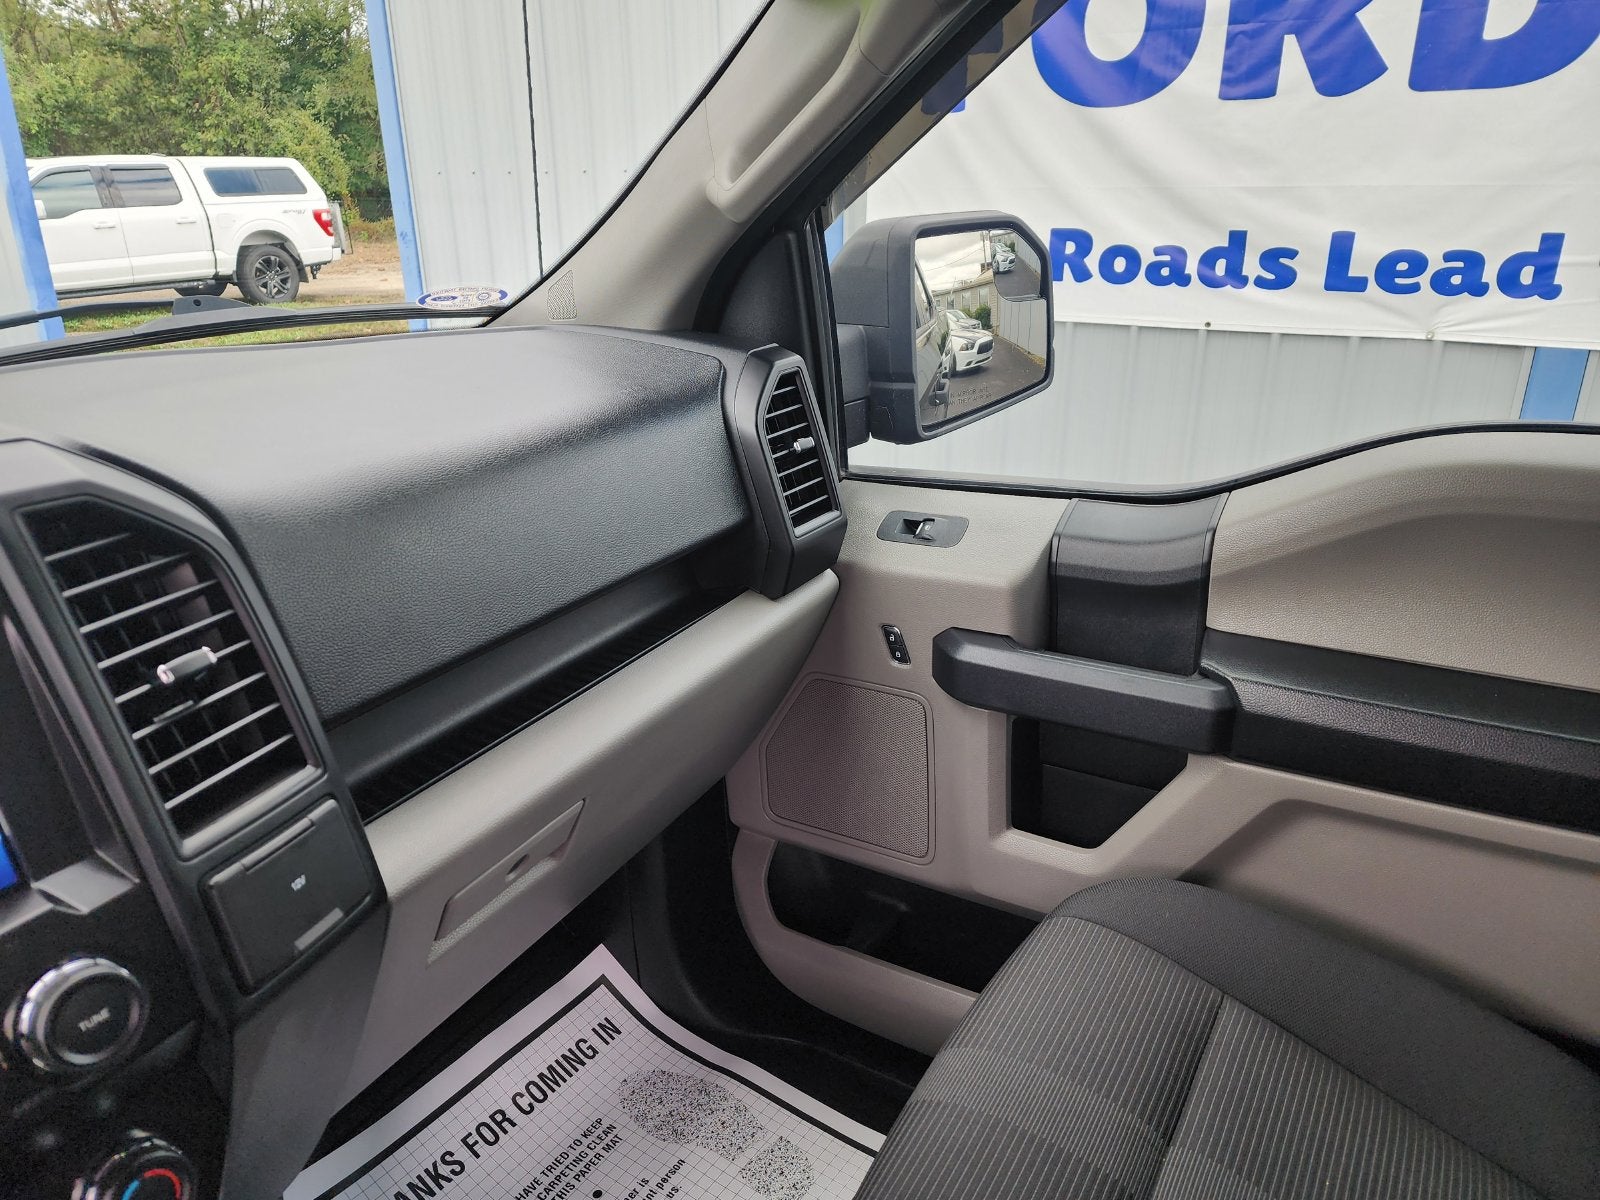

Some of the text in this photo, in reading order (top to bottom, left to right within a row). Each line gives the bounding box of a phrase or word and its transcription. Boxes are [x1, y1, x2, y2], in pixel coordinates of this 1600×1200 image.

[921, 0, 1600, 115] ORD
[1049, 227, 1567, 301] Roads Lead
[78, 1008, 110, 1032] TUNE
[460, 1108, 517, 1159] FOR
[511, 1037, 600, 1115] COMING
[591, 1017, 623, 1046] IN
[537, 1124, 617, 1200] CARPETING CLEAN
[540, 1151, 570, 1179] TRIED
[567, 1138, 583, 1152] TO
[583, 1117, 604, 1140] KEEP
[573, 1153, 605, 1183] PAPER
[602, 1134, 624, 1154] MAT
[636, 1177, 650, 1188] is
[642, 1159, 686, 1200] nt person
